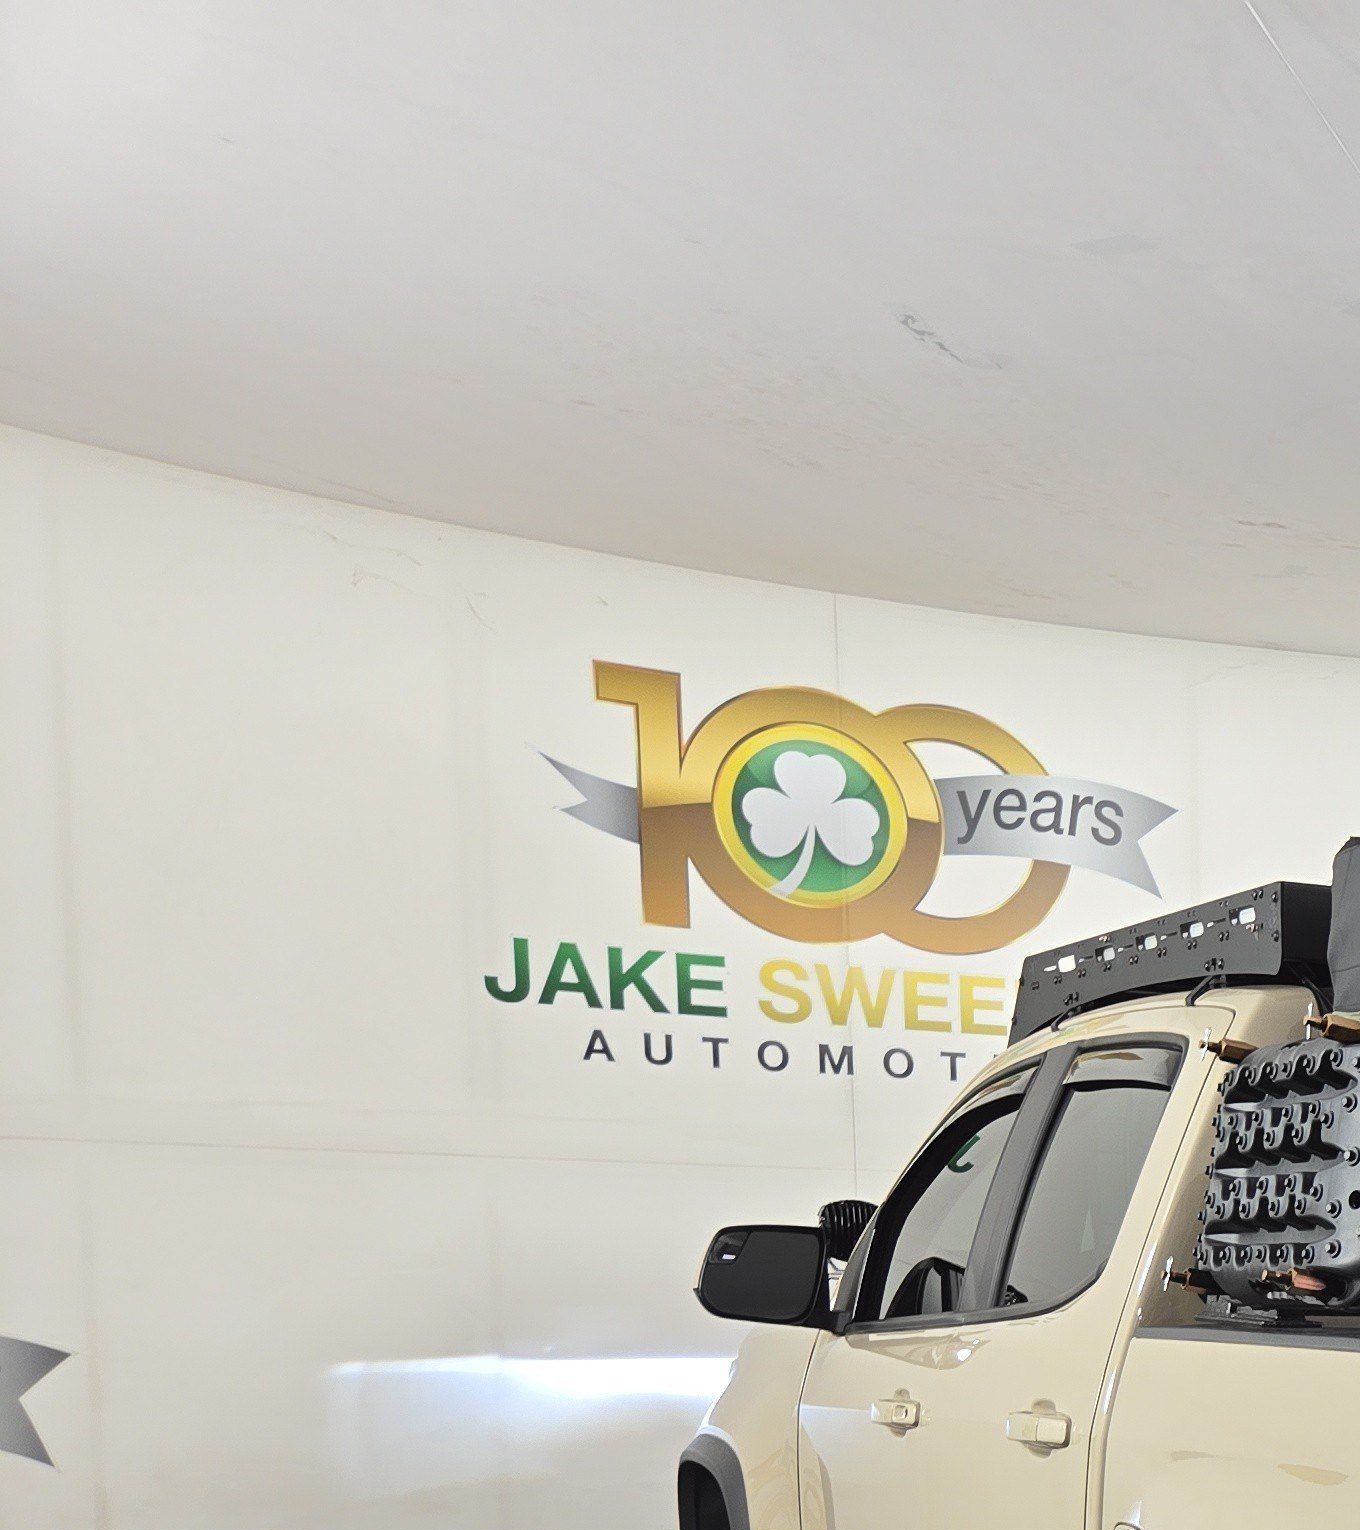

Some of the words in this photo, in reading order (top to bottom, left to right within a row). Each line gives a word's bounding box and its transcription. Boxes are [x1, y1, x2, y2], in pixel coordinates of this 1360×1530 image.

[955, 784, 1126, 847] years
[483, 937, 728, 1018] JAKE
[757, 959, 1021, 1037] SWEE
[582, 1029, 999, 1082] AUTOMOT
